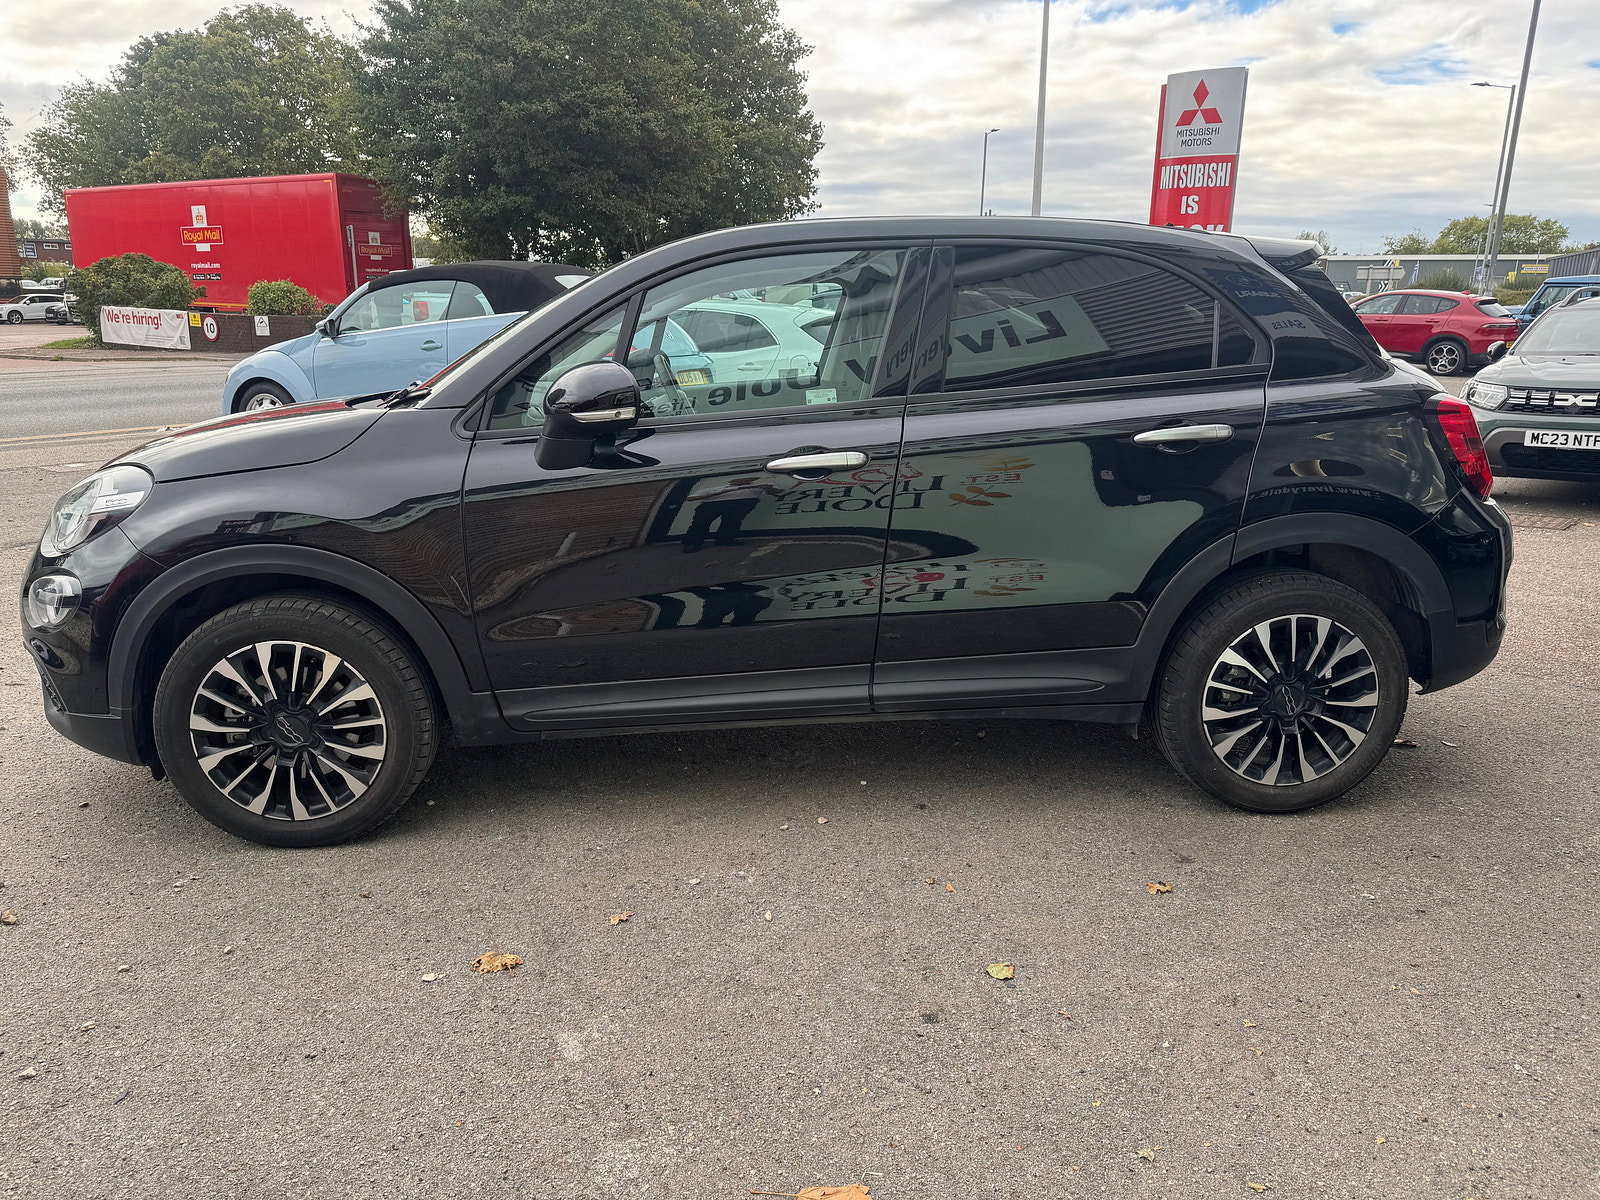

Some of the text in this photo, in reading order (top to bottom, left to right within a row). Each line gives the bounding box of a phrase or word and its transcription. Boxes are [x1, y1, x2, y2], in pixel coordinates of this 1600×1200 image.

[1176, 127, 1220, 138] MITSUBISHI
[1180, 138, 1212, 148] MOTORS
[1160, 163, 1232, 190] MITSUBISHI
[1180, 195, 1199, 214] IS
[183, 230, 220, 242] Royal Mail
[360, 245, 391, 254] Royal Mail
[190, 262, 221, 270] royalmail.com
[104, 308, 163, 330] We're hiring!
[205, 322, 215, 334] 10
[1530, 432, 1569, 446] MC23
